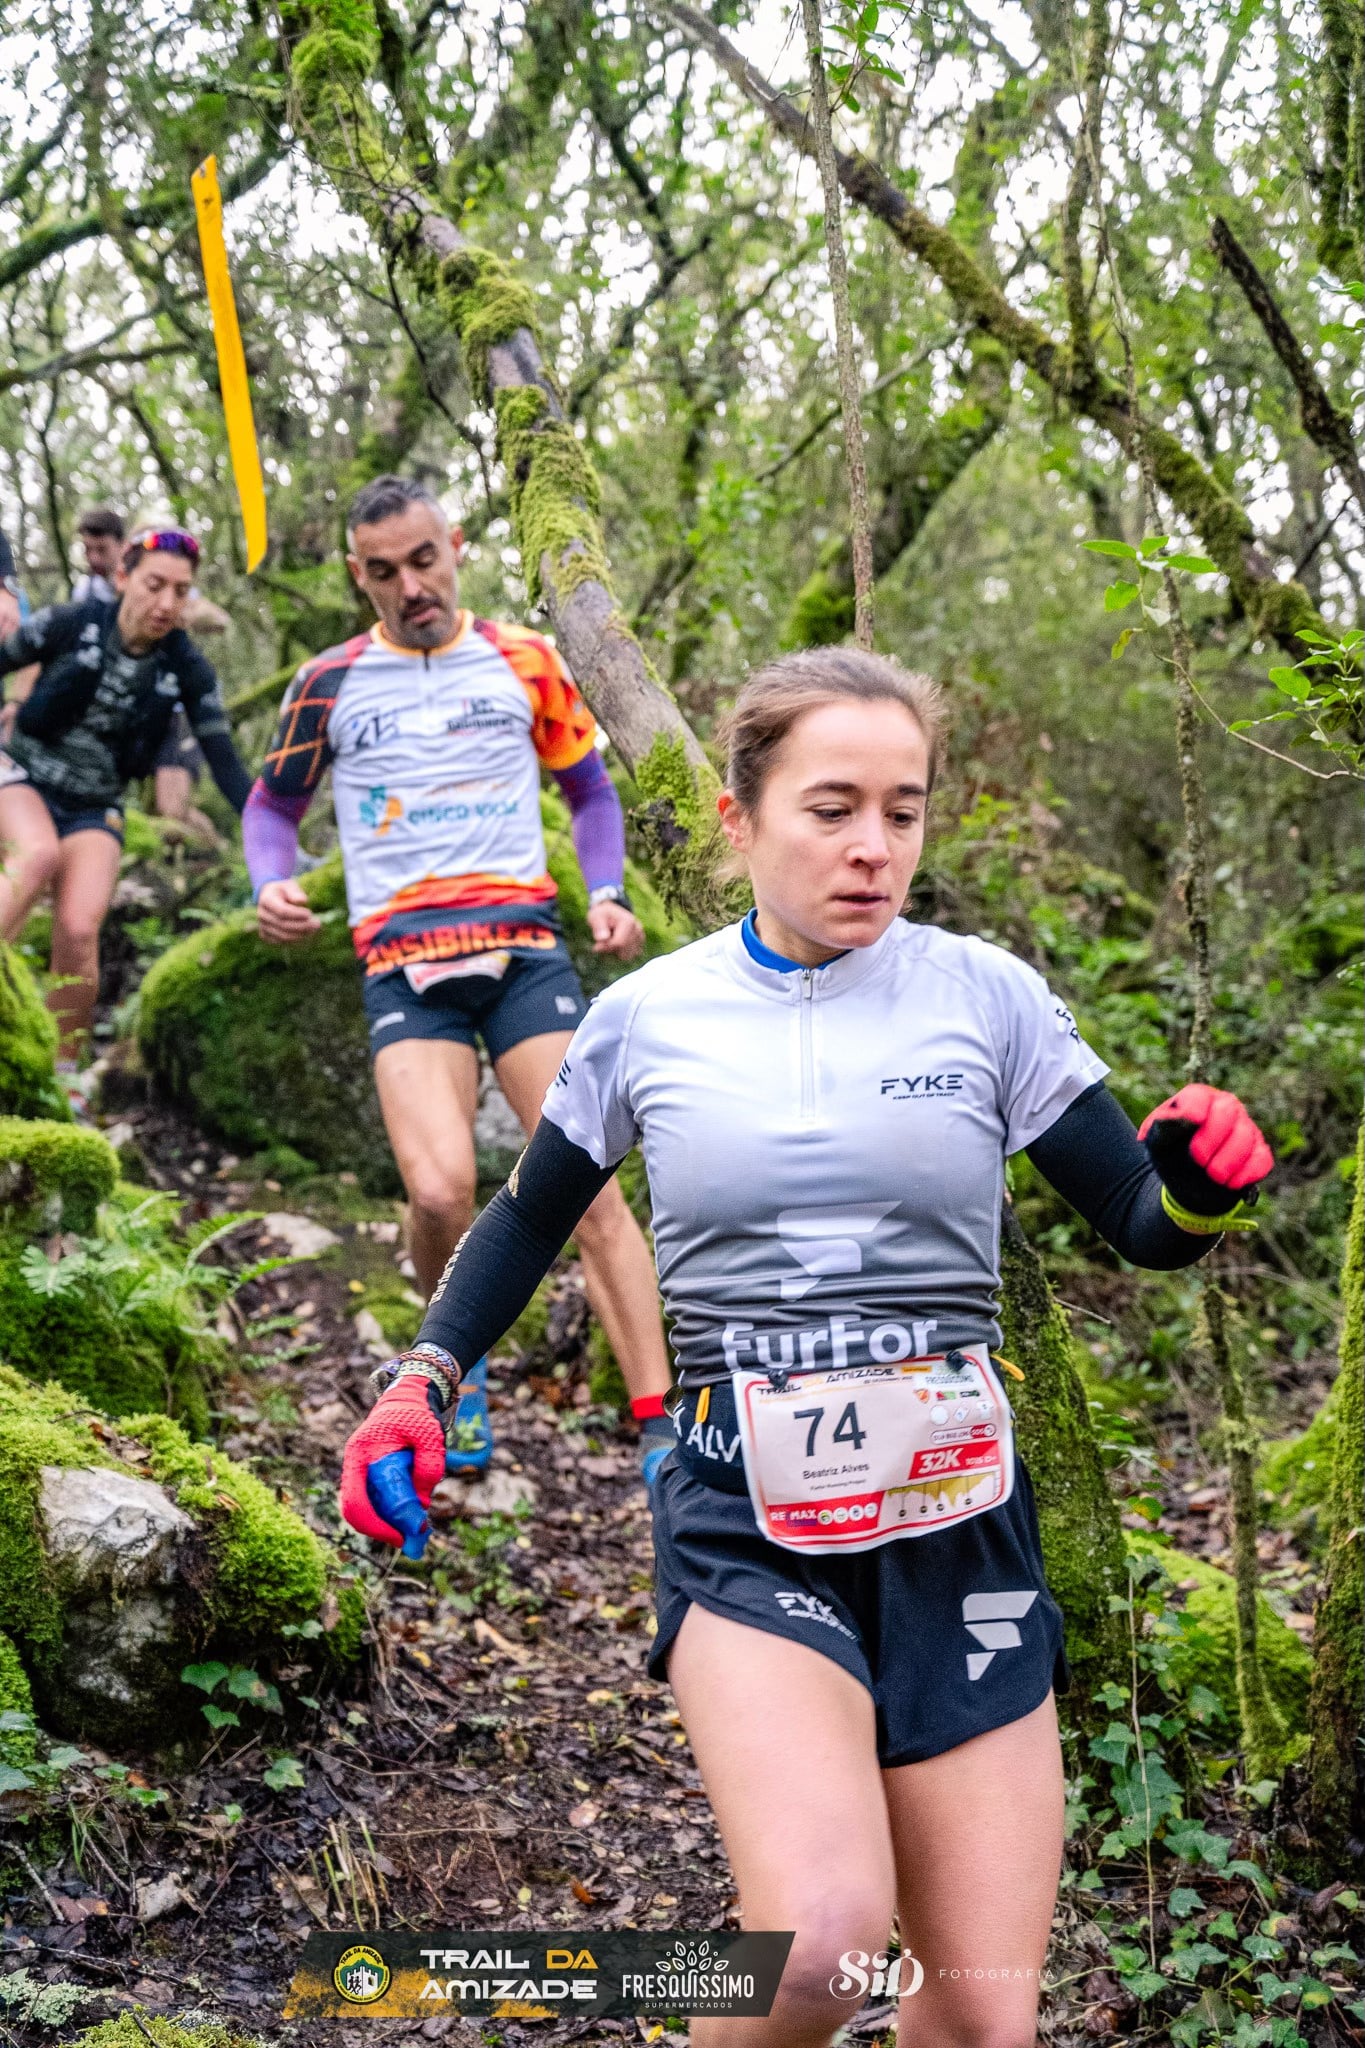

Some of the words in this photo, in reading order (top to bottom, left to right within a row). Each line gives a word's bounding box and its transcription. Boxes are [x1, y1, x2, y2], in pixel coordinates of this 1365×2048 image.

[881, 1074, 963, 1094] FYKE
[722, 1314, 938, 1373] FurFor
[685, 1422, 741, 1463] ALV
[793, 1401, 867, 1457] 74
[803, 1466, 839, 1480] Beatriz
[841, 1463, 870, 1474] Alves
[918, 1447, 964, 1474] 32K
